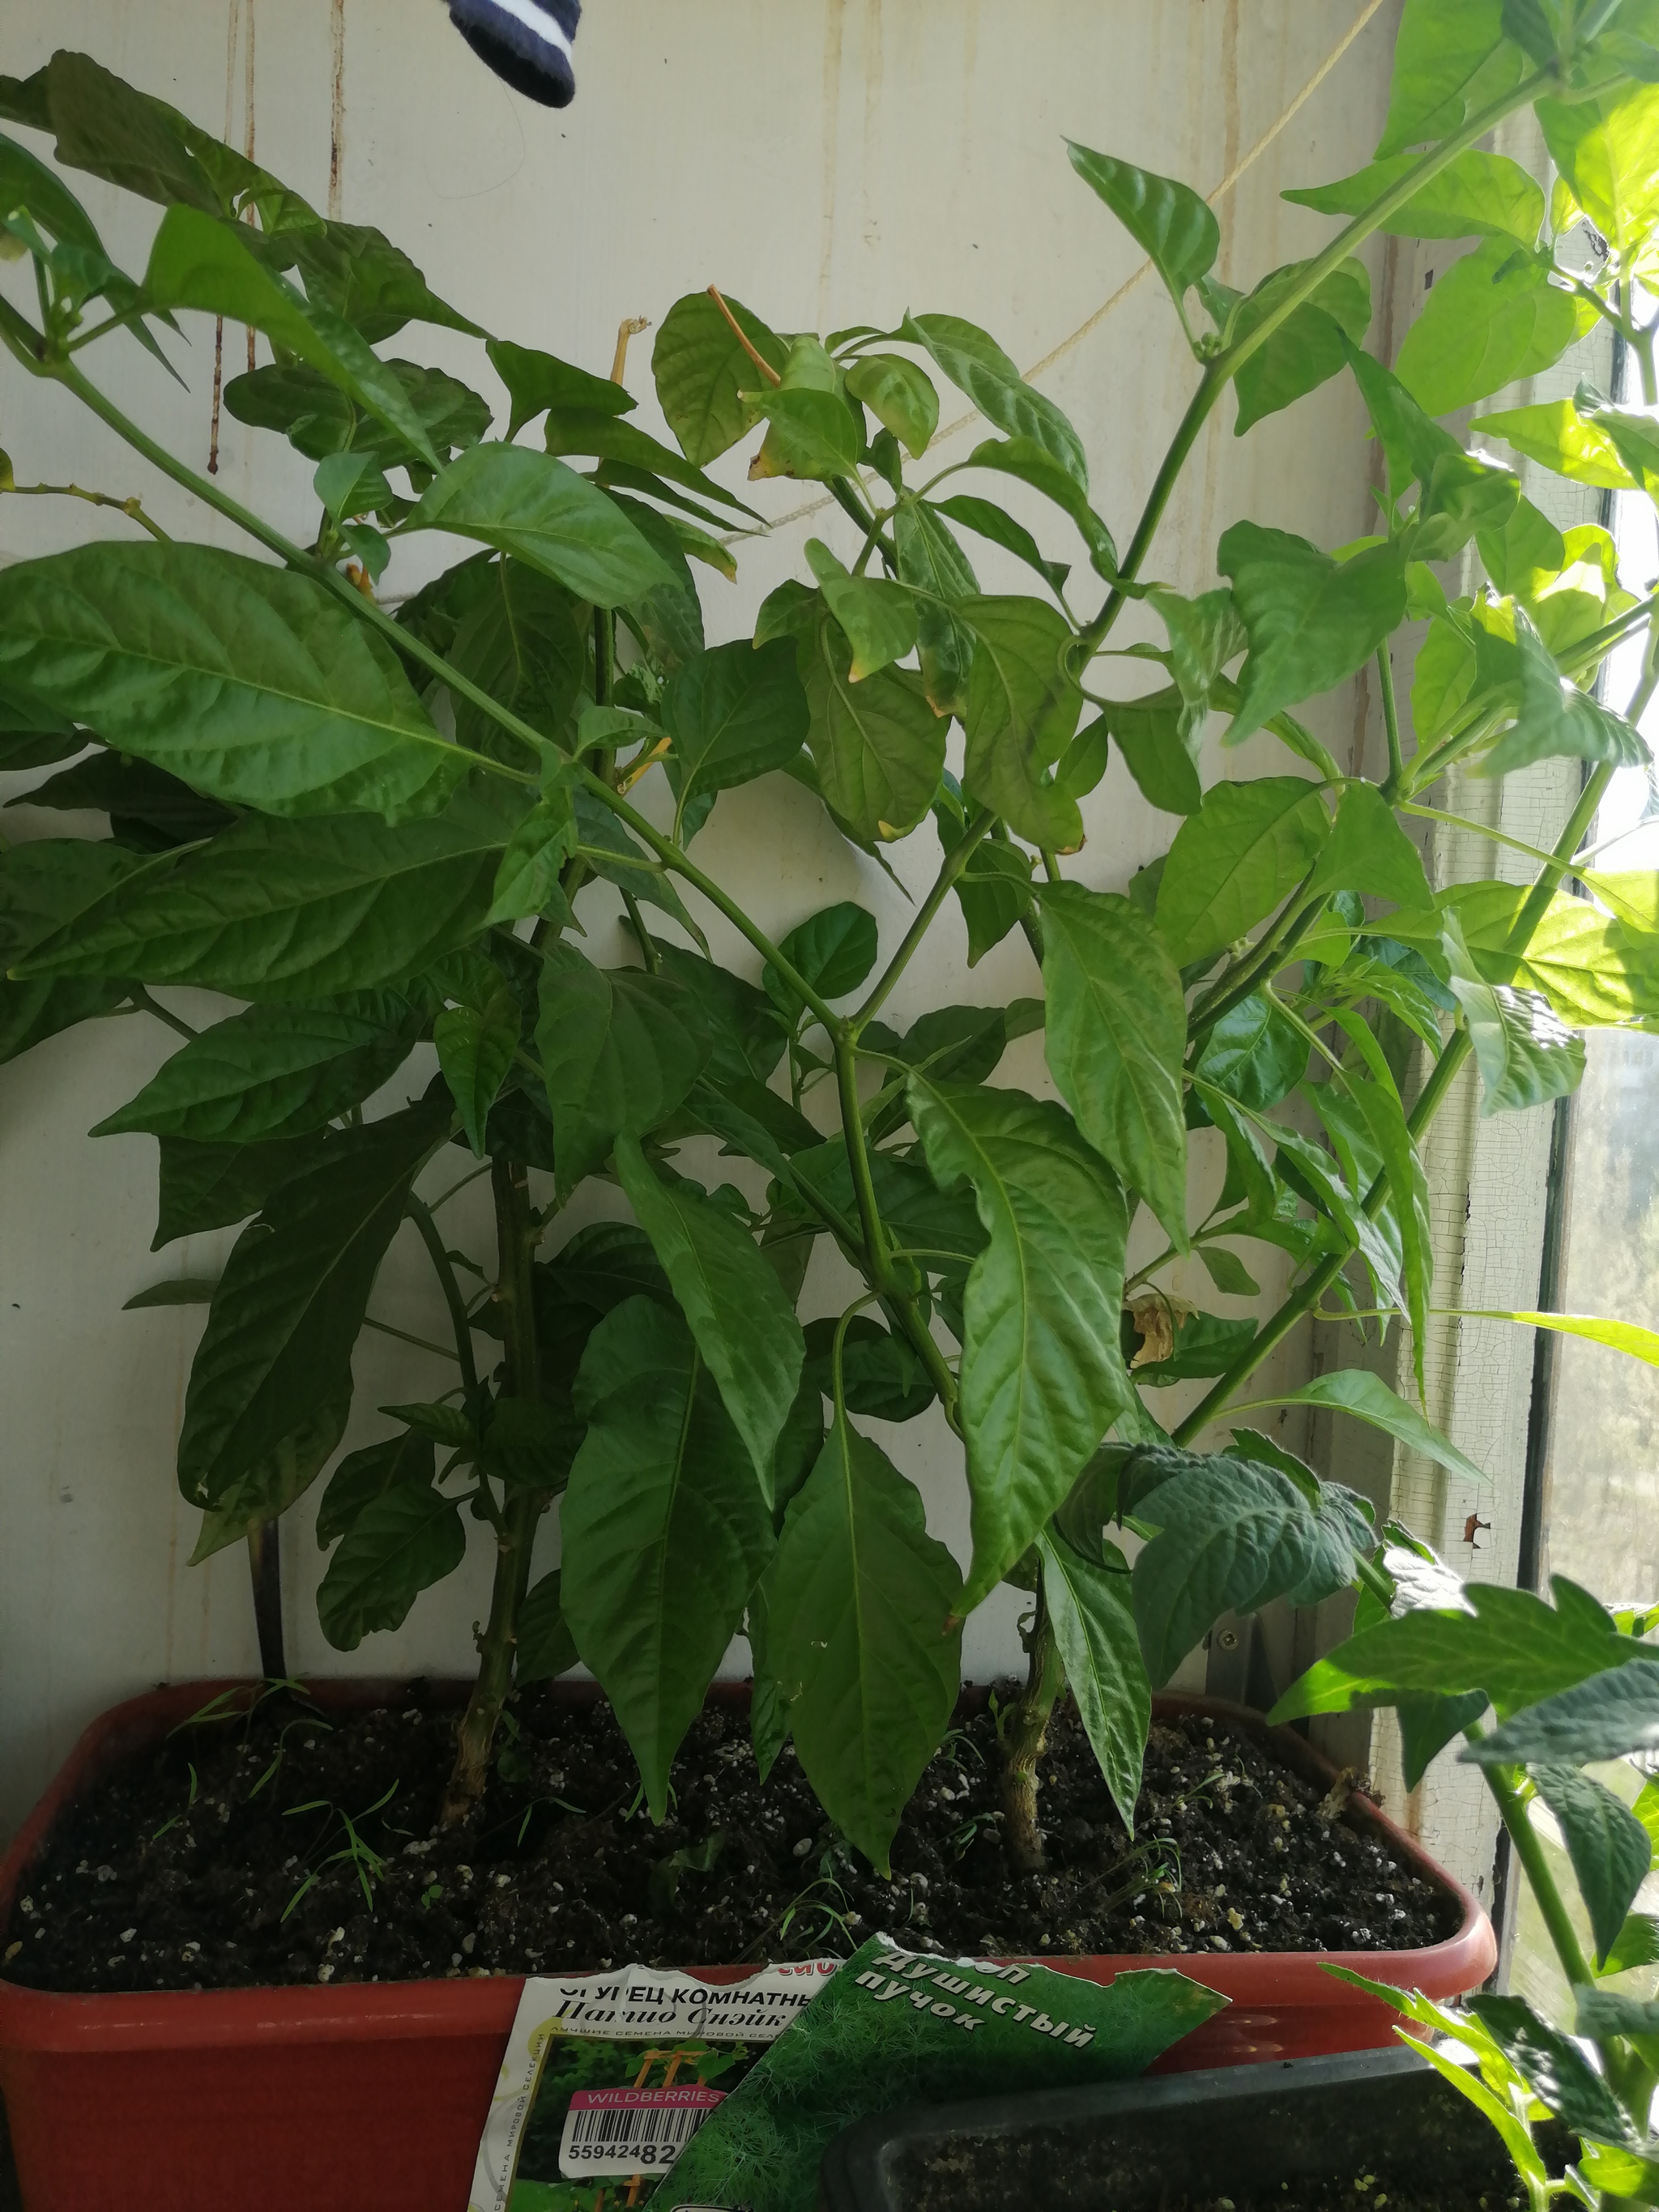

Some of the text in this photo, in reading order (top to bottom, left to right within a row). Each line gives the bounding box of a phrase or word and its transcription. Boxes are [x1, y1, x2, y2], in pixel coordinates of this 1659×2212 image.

[688, 2008, 786, 2027] Снэйк
[854, 1970, 985, 2031] пучок
[870, 1950, 1097, 2048] Душистый
[551, 2027, 609, 2035] ЛУЧШИЕ
[676, 2030, 744, 2038] МИРОВОЙ
[587, 2091, 719, 2104] WILDBERRIES
[494, 2034, 545, 2211] СЕМЕНА МИРОВОЙ СЕЛЕКЦИИ
